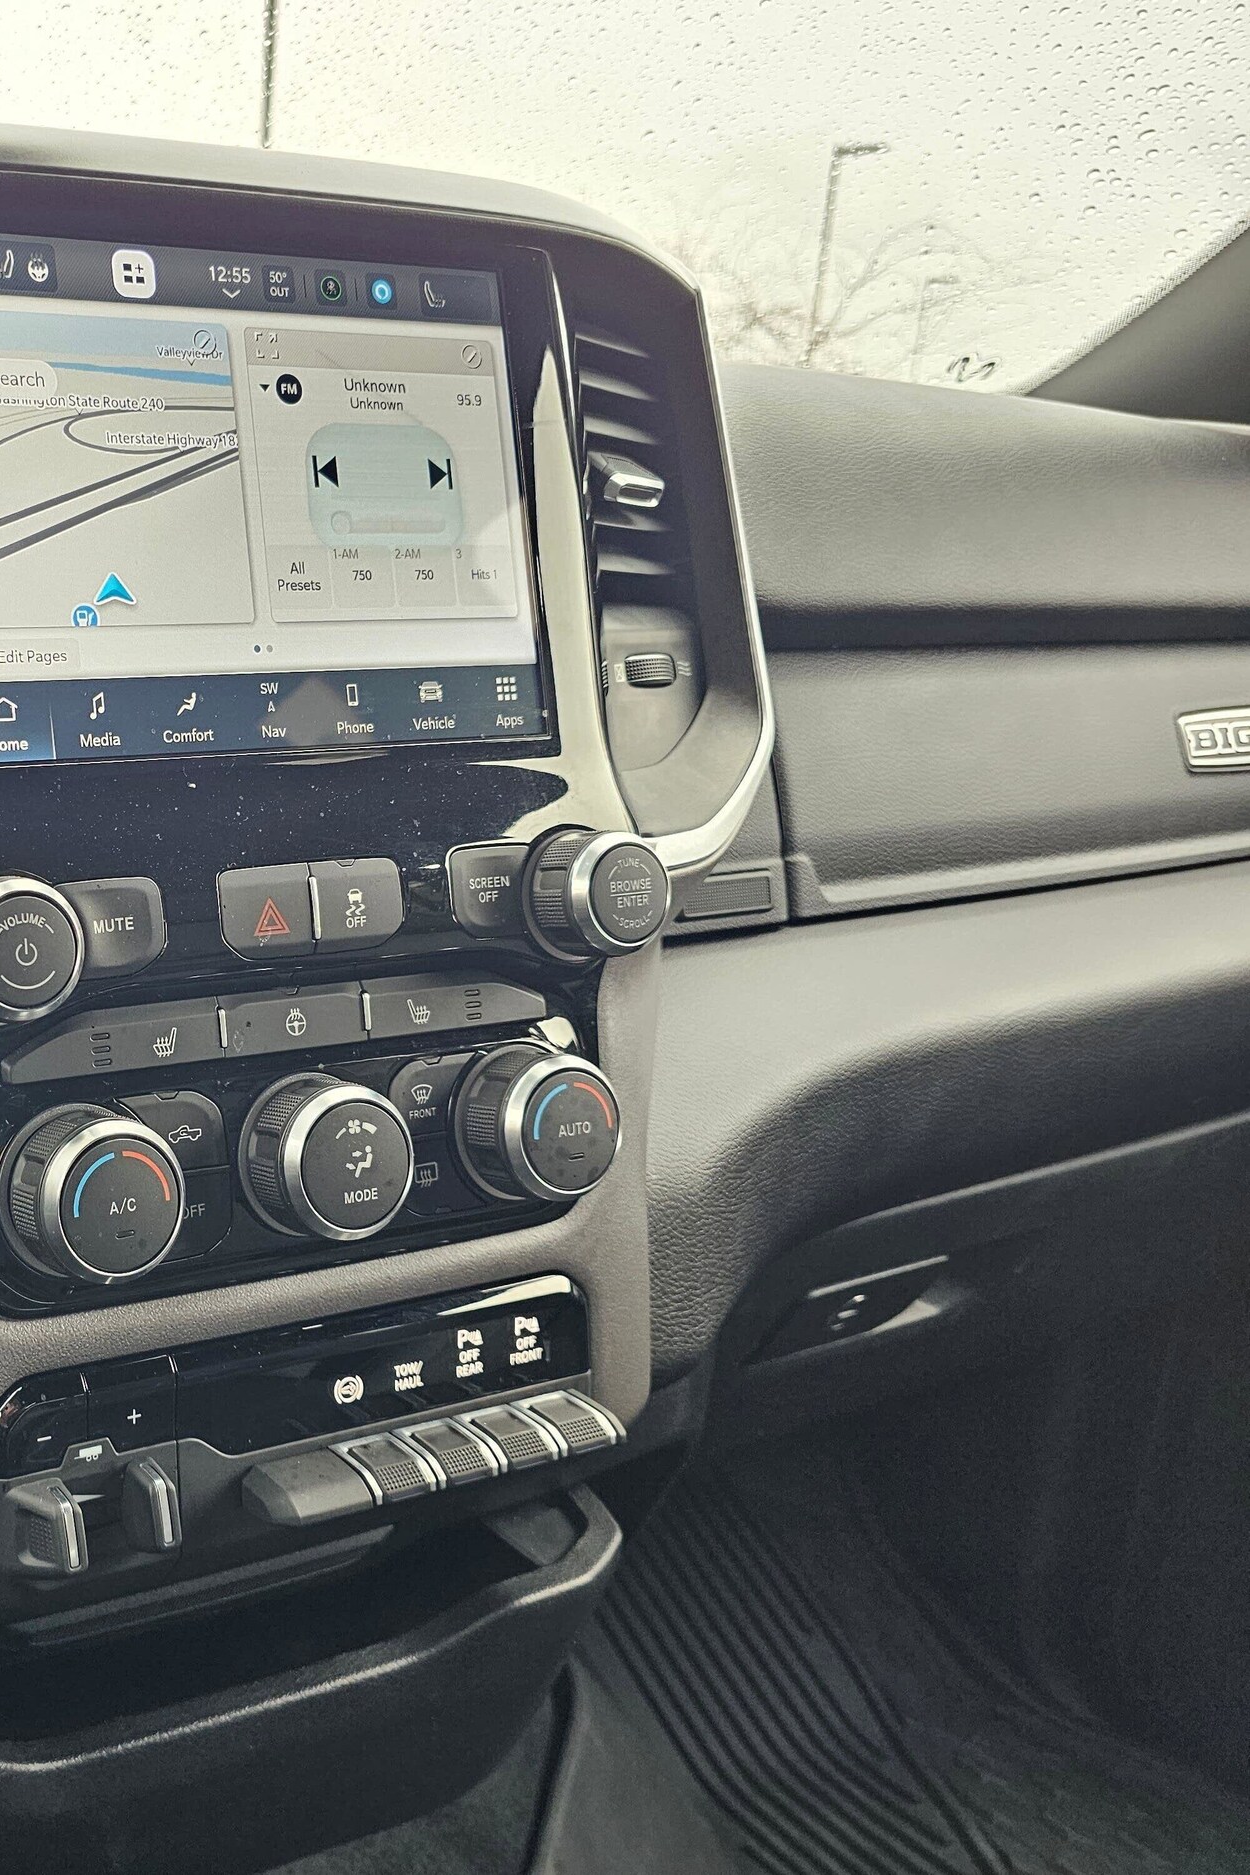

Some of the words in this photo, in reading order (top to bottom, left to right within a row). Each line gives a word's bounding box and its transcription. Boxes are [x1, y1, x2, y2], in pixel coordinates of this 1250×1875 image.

[208, 265, 251, 284] 12:55
[270, 286, 290, 298] OUT
[281, 382, 297, 396] FM
[344, 377, 406, 394] Unknown
[68, 394, 100, 407] State
[103, 396, 138, 409] Route
[141, 397, 164, 410] 240
[350, 397, 404, 411] Unknown
[456, 394, 481, 407] 95.9
[106, 431, 164, 445] Interstate
[167, 433, 219, 448] Highway
[222, 433, 238, 447] 18
[333, 548, 359, 560] 1-AM
[394, 548, 421, 560] 2-AM
[290, 561, 305, 575] All
[352, 569, 372, 581] 750
[414, 569, 434, 581] 750
[470, 568, 491, 580] Hits
[277, 578, 321, 592] Presets
[26, 650, 68, 666] Pages
[260, 682, 279, 695] SW
[337, 721, 374, 735] Phone
[413, 716, 455, 731] Vehicle
[496, 714, 524, 728] Apps
[163, 728, 214, 743] Comfort
[261, 725, 287, 738] Nav
[79, 732, 121, 748] Media
[617, 857, 641, 869] TUNE
[469, 875, 510, 890] SCREEN
[610, 877, 652, 892] BROWSE
[478, 891, 499, 903] OFF
[617, 894, 650, 909] ENTER
[0, 912, 47, 931] VOLUME
[93, 916, 135, 934] MUTE
[346, 915, 367, 929] OFF
[618, 913, 651, 929] SCROLL
[409, 1107, 436, 1120] FRONT
[558, 1121, 591, 1138] AUTO
[344, 1187, 378, 1205] MODE
[109, 1197, 137, 1216] A/C
[515, 1335, 537, 1351] OFF
[458, 1348, 481, 1364] OFF
[509, 1347, 543, 1366] FRONT
[455, 1363, 484, 1379] REAR
[394, 1375, 424, 1392] HAUL
